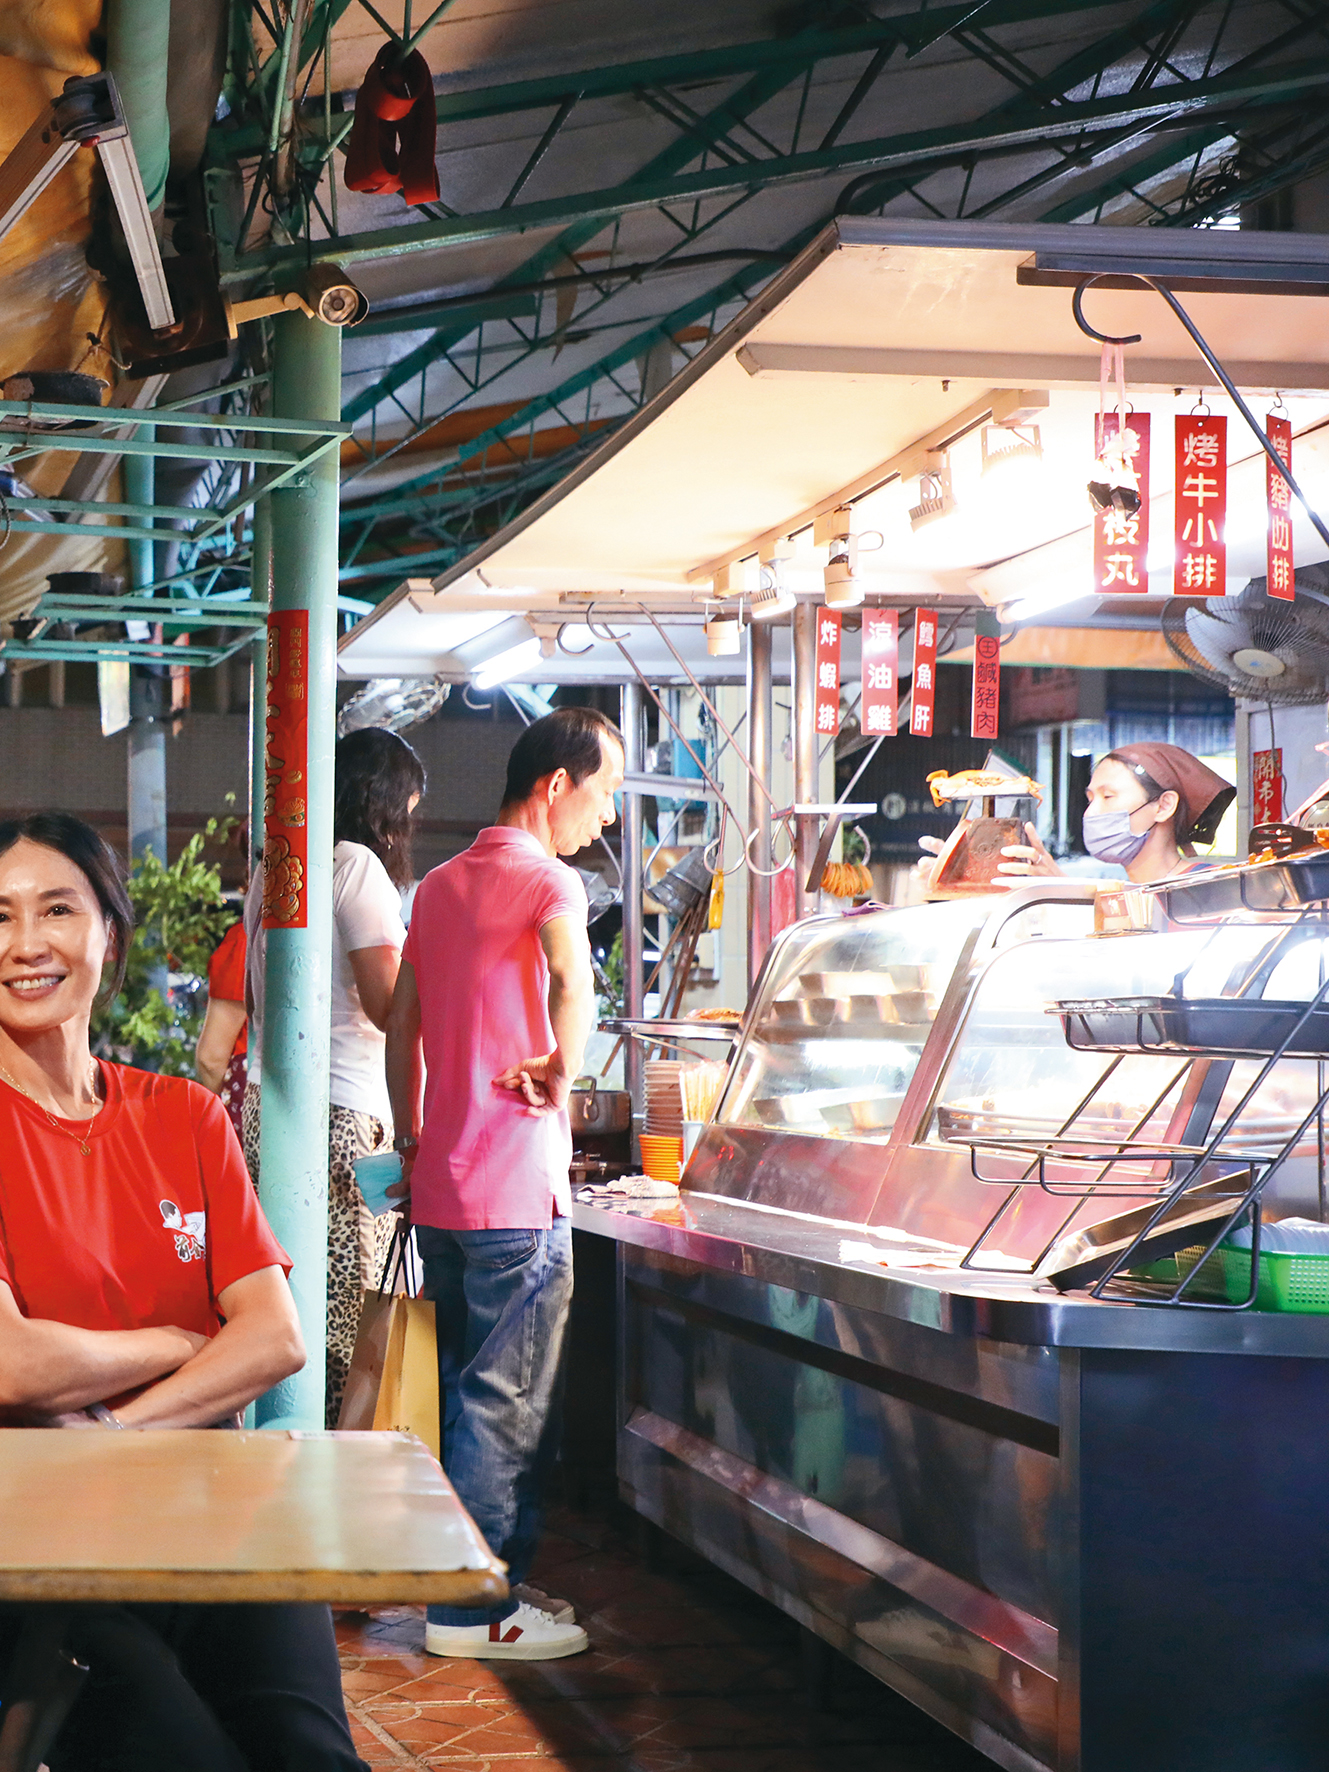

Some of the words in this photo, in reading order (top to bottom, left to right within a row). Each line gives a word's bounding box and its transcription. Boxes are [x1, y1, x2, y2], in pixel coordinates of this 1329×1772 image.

[1182, 432, 1219, 588] 烤牛小排
[818, 620, 837, 731] 炸蝦排
